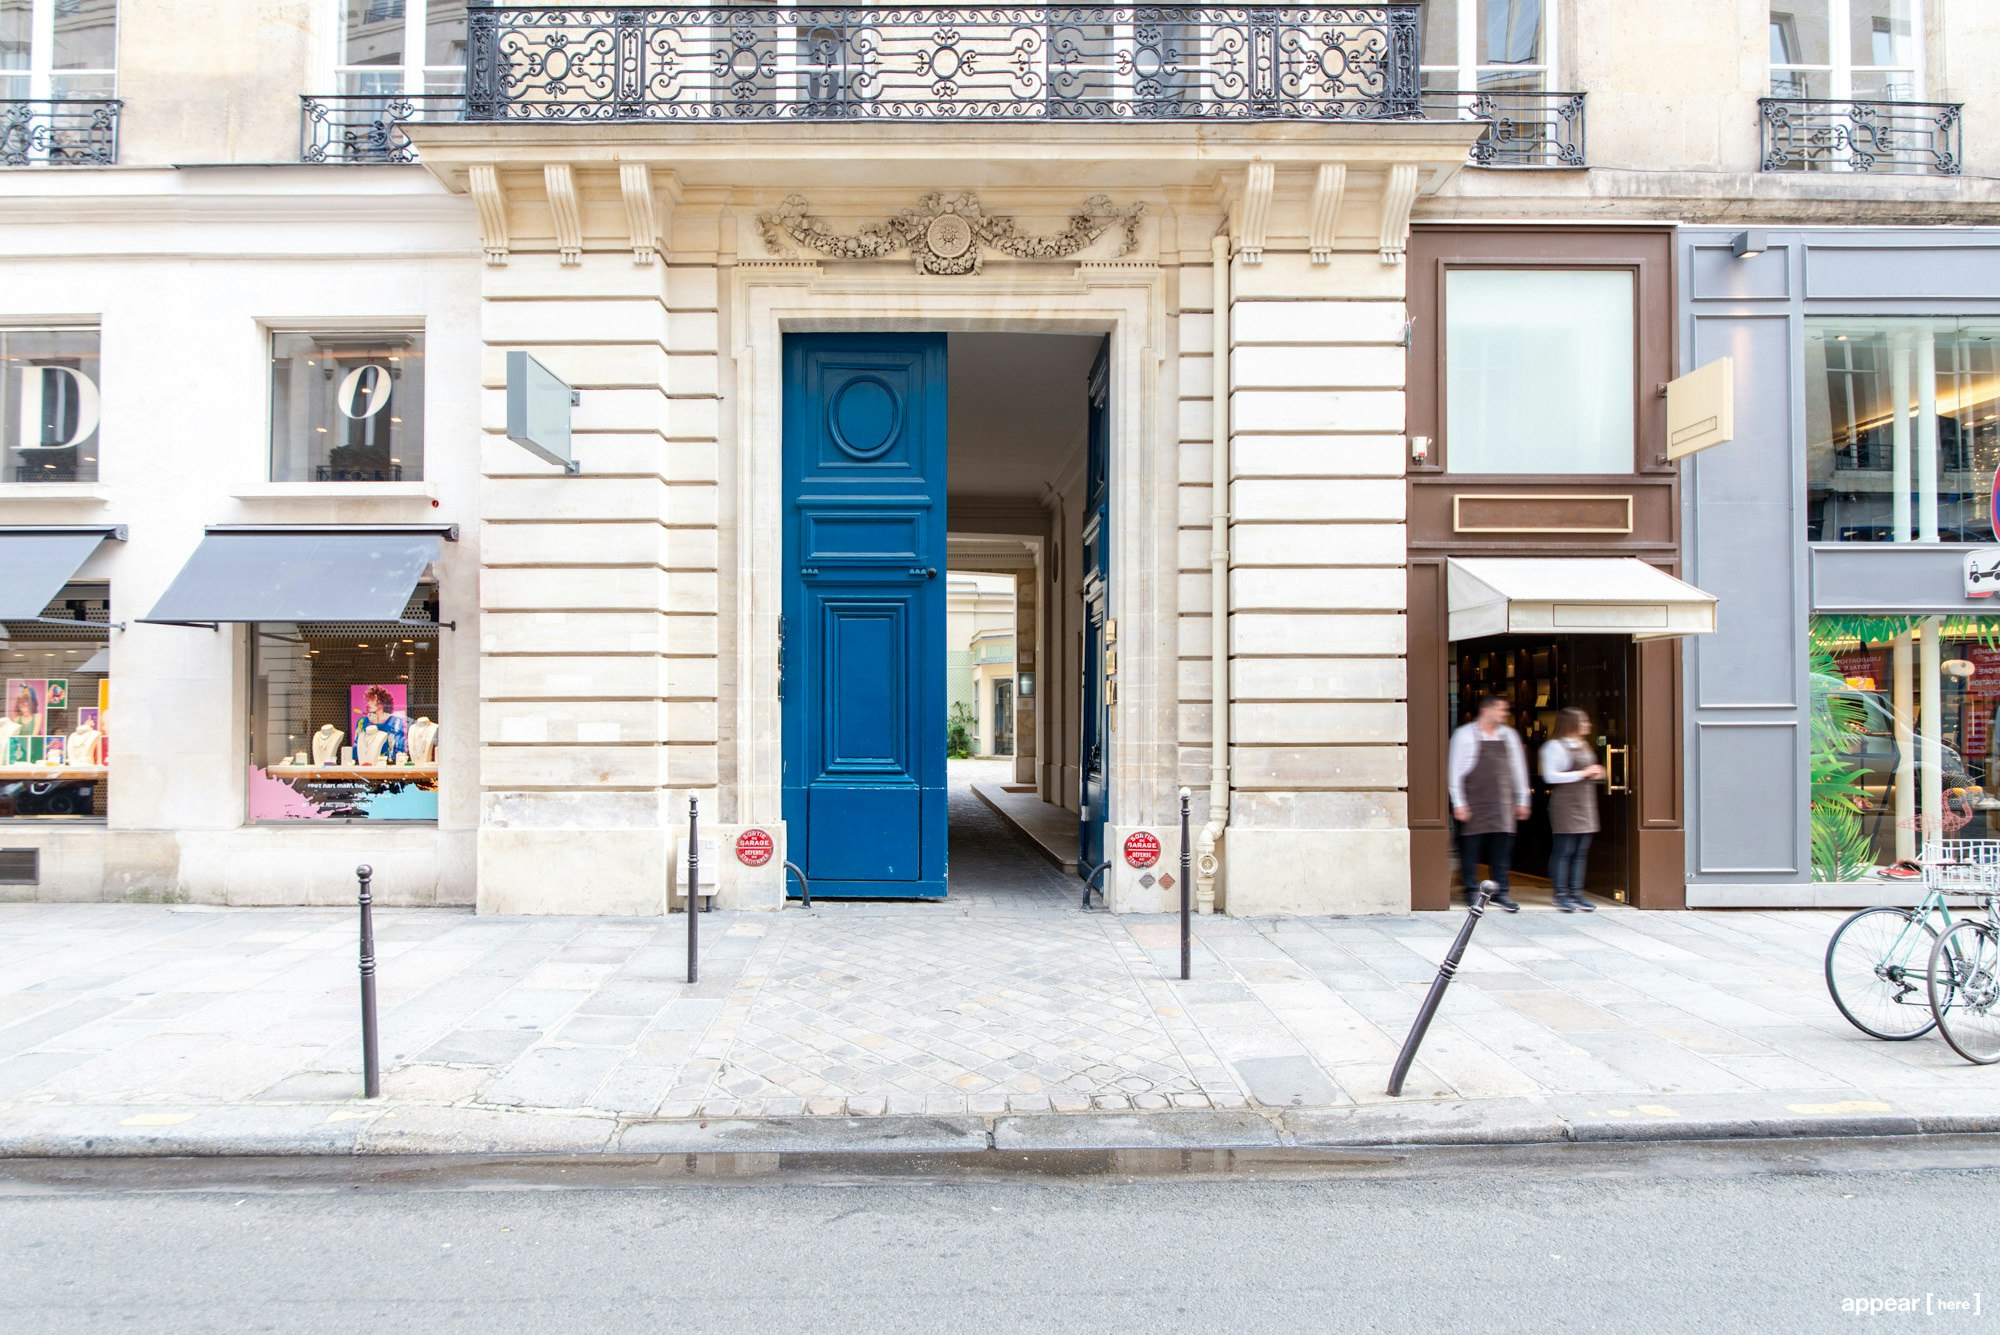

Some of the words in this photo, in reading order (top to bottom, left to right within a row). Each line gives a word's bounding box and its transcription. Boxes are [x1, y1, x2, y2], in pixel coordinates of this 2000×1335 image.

[9, 365, 101, 450] D
[743, 830, 767, 840] SORTIE
[1130, 832, 1154, 842] SORTIE
[740, 853, 769, 865] STATIONNER
